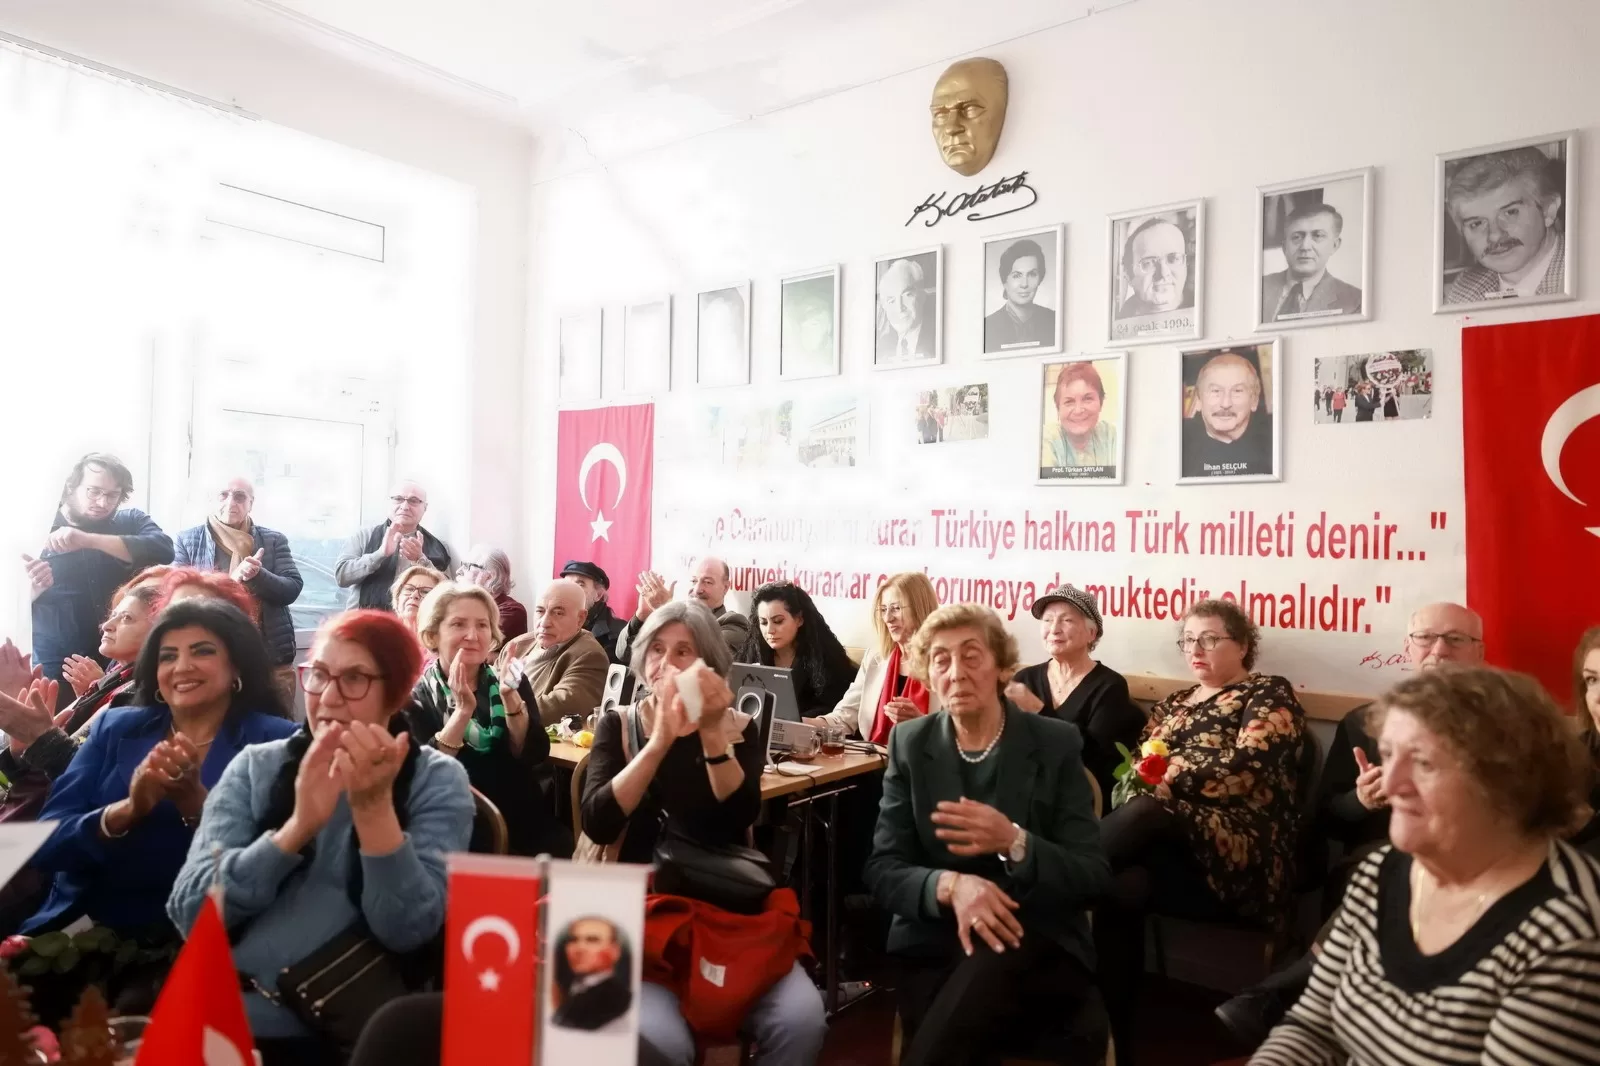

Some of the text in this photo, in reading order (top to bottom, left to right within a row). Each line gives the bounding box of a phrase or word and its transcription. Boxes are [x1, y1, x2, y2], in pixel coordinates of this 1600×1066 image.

[1221, 462, 1248, 471] SELÇUK
[931, 508, 1016, 560] Türkiye
[1024, 509, 1116, 553] halkına
[1125, 510, 1190, 554] Türk
[1200, 511, 1295, 557] milleti
